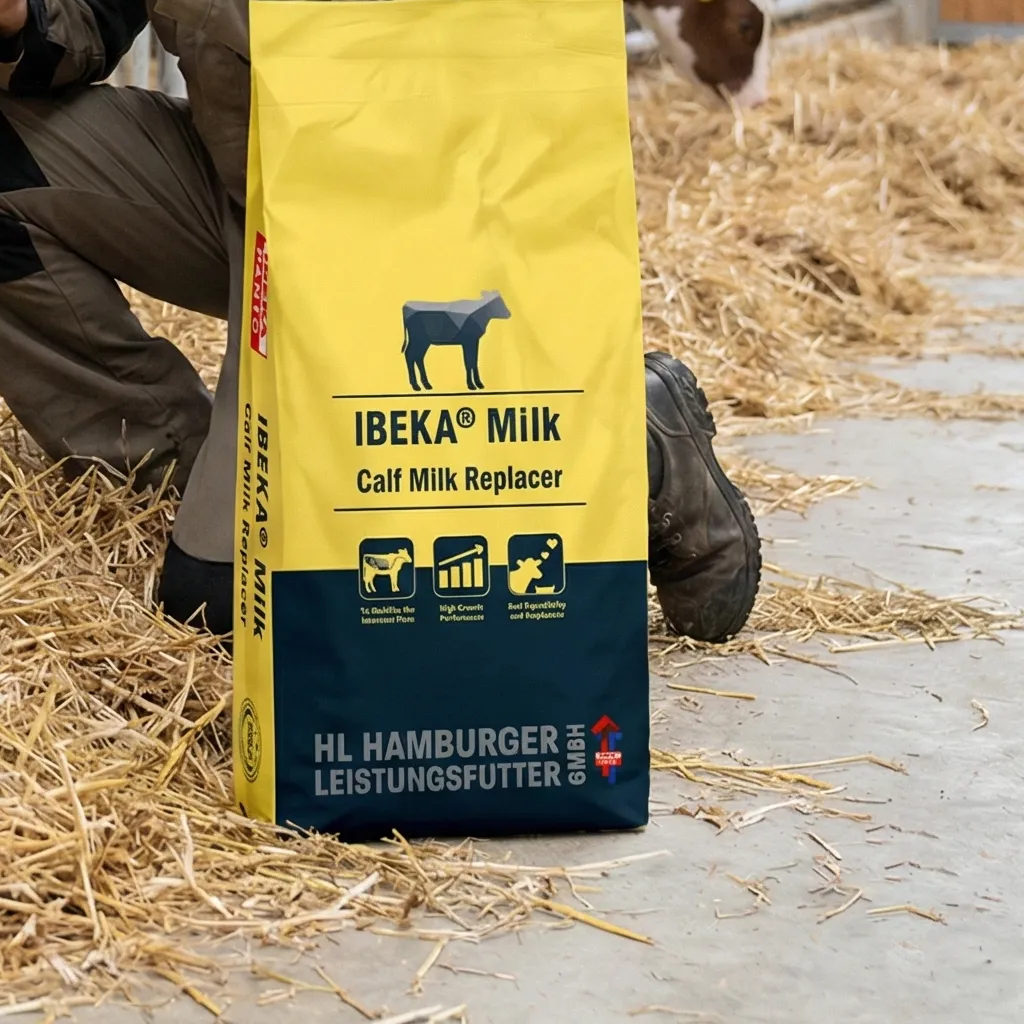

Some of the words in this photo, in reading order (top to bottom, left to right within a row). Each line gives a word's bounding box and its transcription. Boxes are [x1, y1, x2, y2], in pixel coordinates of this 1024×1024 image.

[355, 406, 476, 446] IBEKA®
[488, 406, 561, 443] Milk
[357, 467, 402, 493] Calf
[409, 467, 458, 492] Milk
[465, 465, 563, 495] Replacer
[240, 519, 250, 628] Replacer
[253, 558, 267, 641] Milk
[314, 733, 352, 763] HL
[364, 725, 559, 762] HAMBURGER
[315, 761, 562, 796] LEISTUNGSFUTTER
